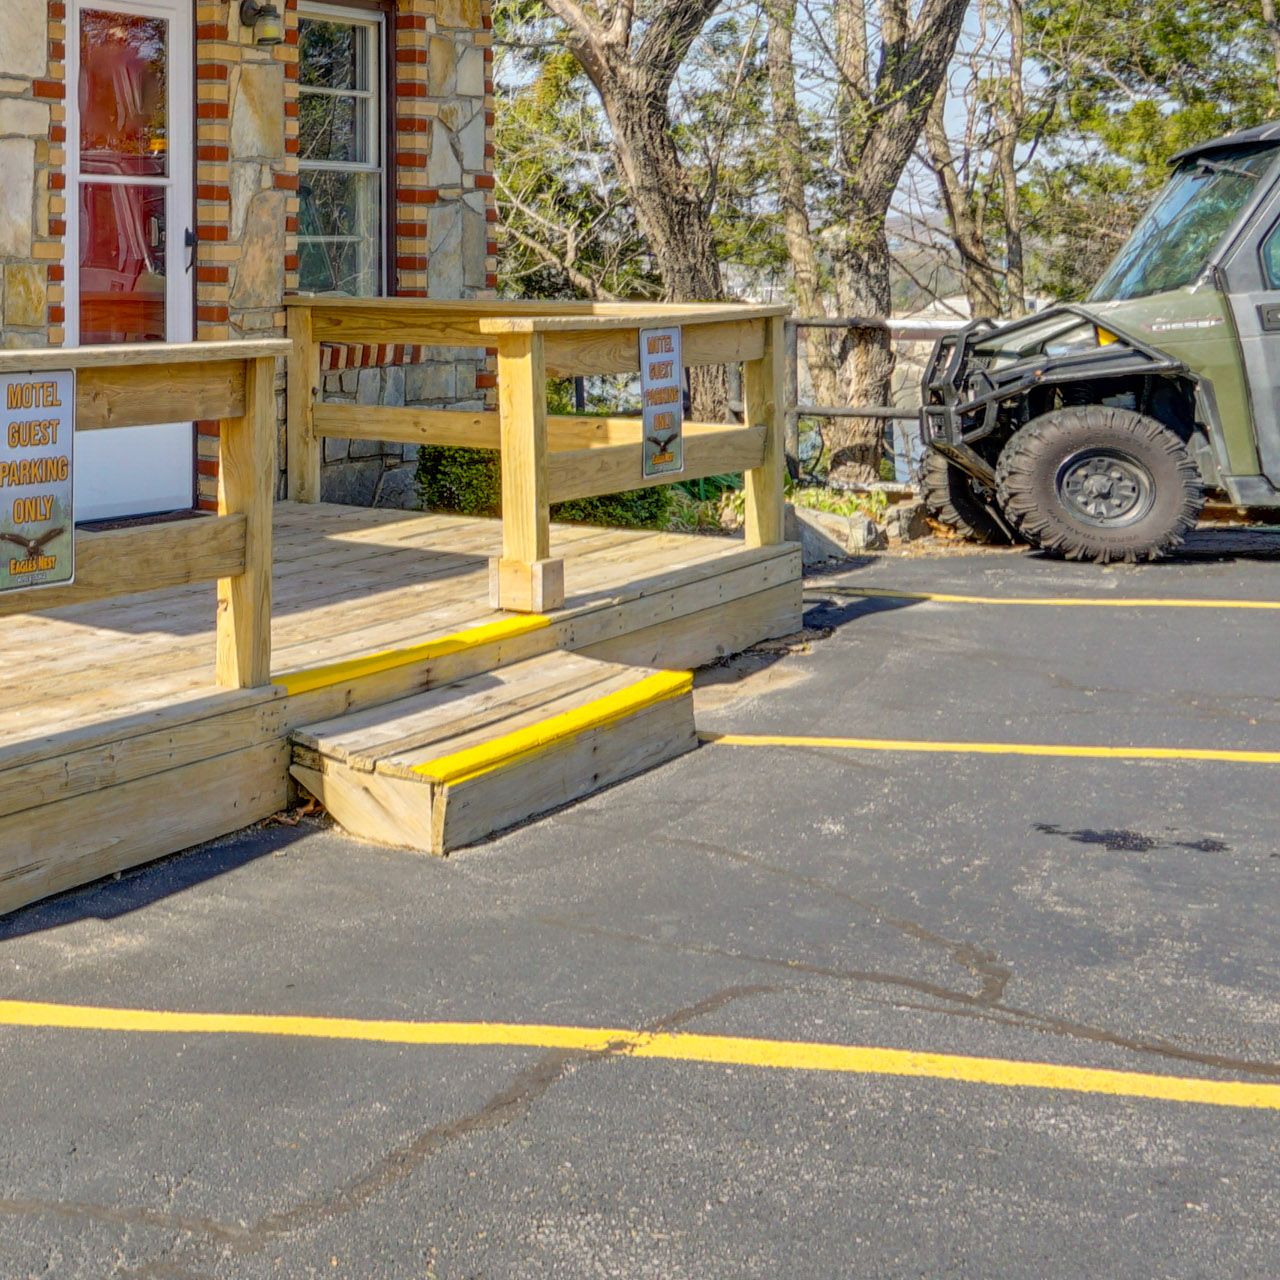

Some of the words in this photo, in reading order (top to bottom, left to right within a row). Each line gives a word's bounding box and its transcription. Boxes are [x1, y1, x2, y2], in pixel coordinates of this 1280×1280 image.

[647, 335, 674, 354] MOTEL
[7, 381, 62, 409] MOTEL
[7, 419, 60, 448] GUEST
[13, 495, 54, 525] ONLY
[38, 555, 57, 571] NEST
